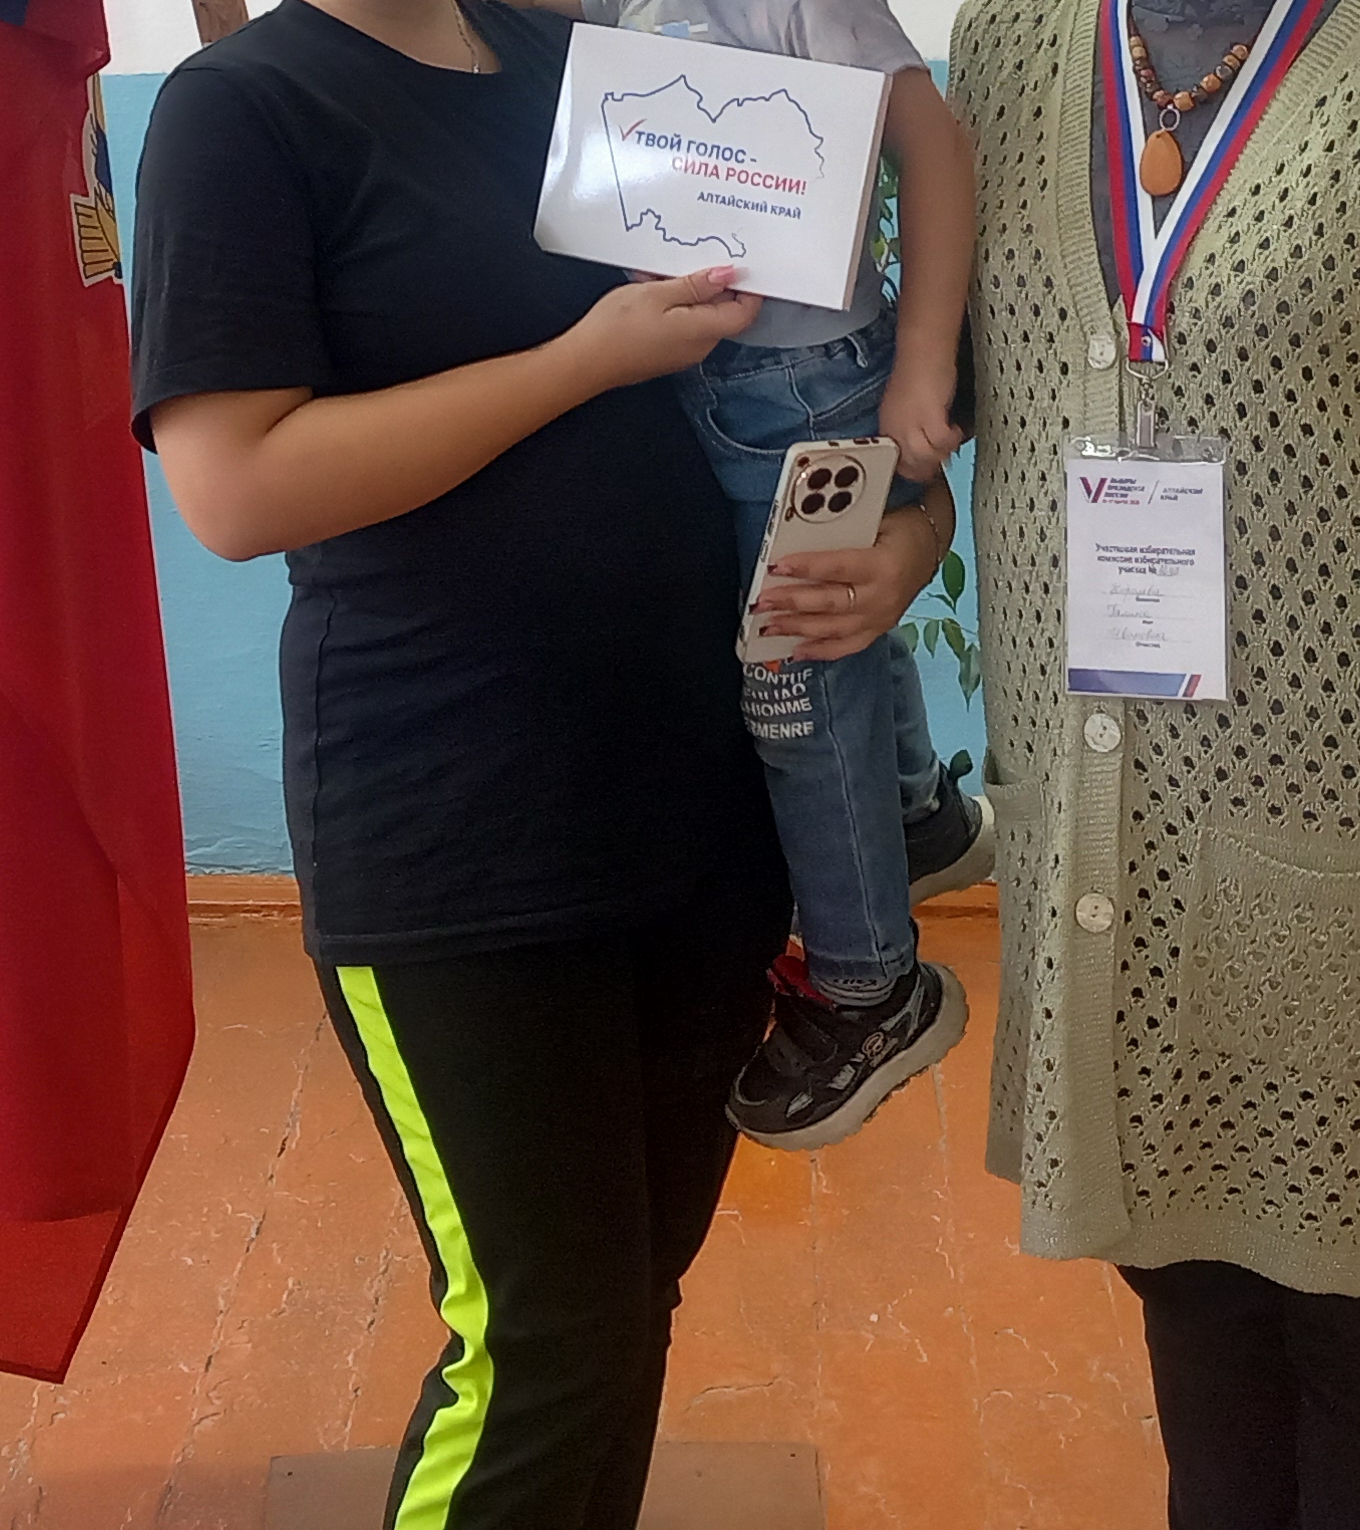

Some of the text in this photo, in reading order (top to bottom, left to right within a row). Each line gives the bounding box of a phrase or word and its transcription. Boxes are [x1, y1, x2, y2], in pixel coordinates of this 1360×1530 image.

[635, 130, 682, 153] ТВОЙ
[686, 141, 746, 164] ГОЛОС
[672, 157, 807, 196] СИЛА РОССИИ!
[697, 191, 801, 220] АЛТАЙСКИЙ КРАЙ
